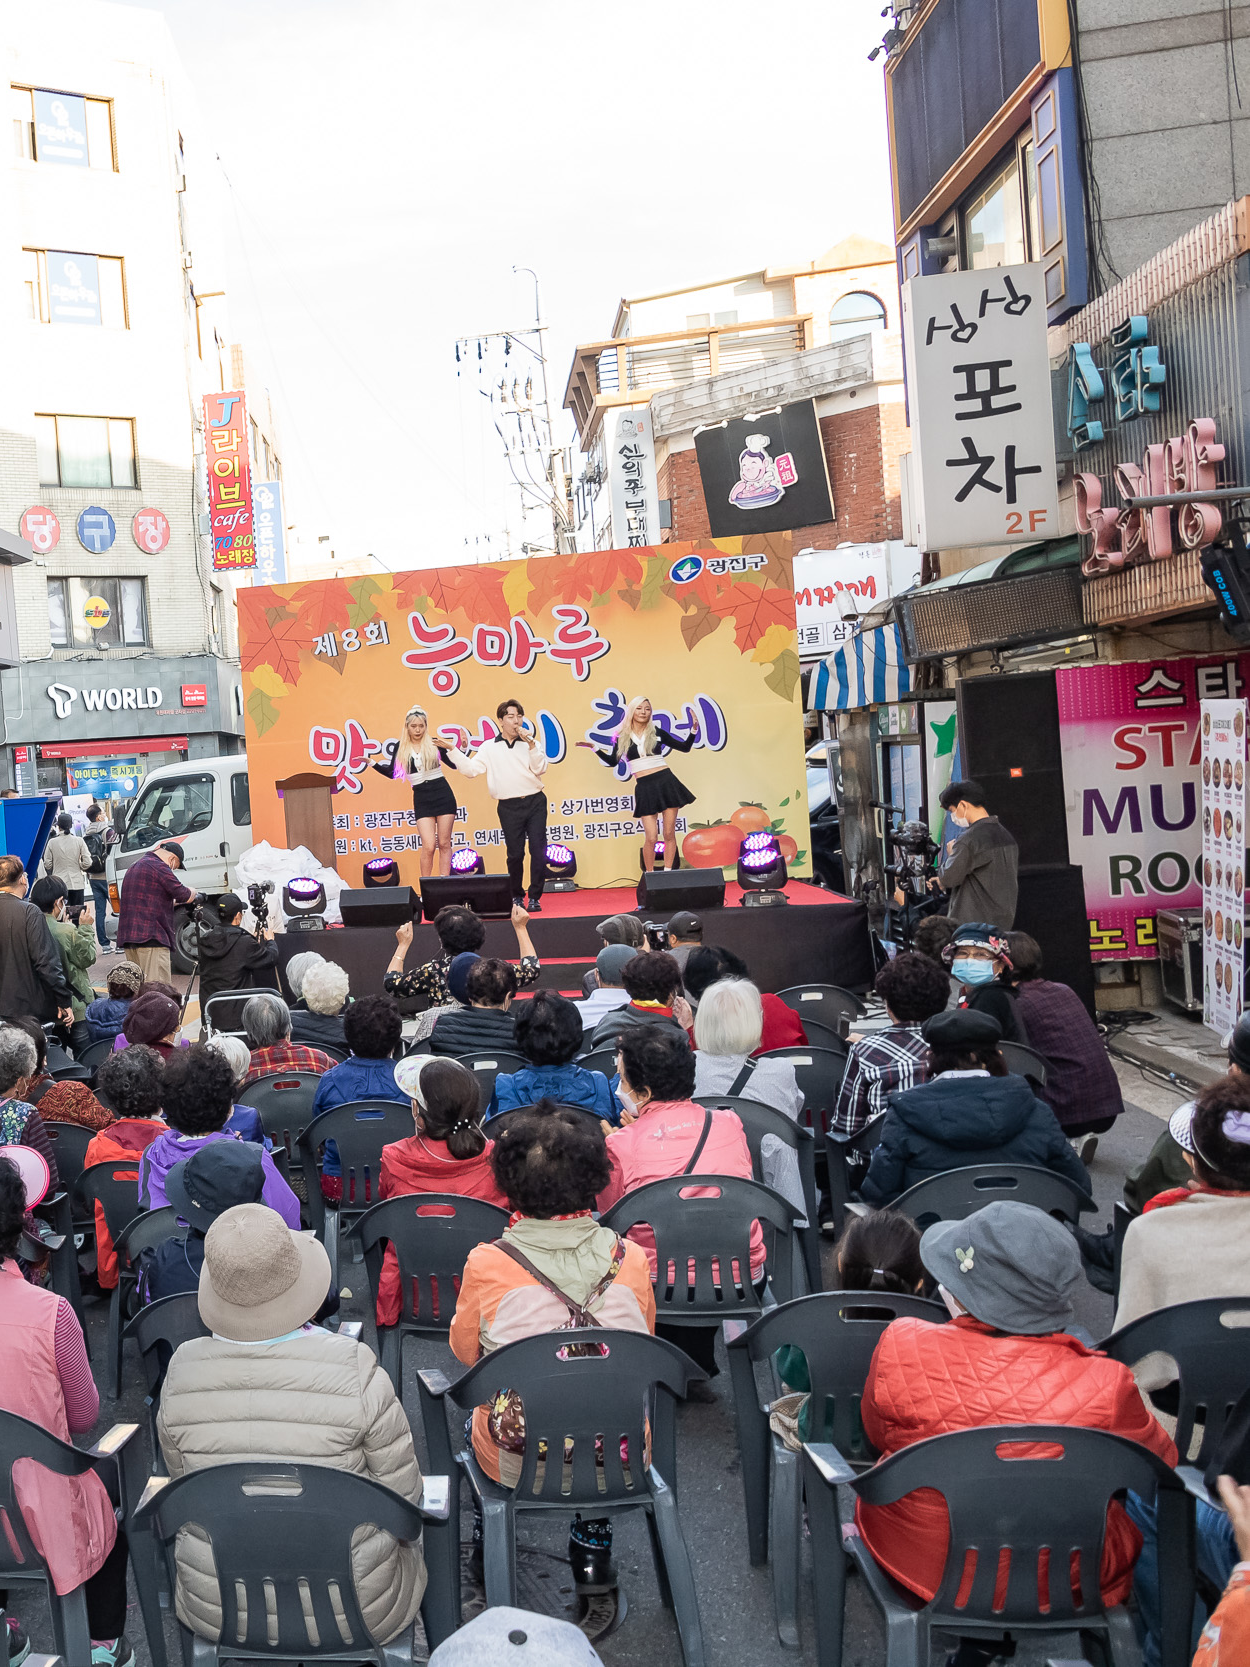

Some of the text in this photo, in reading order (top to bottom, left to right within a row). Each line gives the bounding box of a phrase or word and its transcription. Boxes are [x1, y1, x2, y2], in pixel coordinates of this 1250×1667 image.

[618, 443, 646, 496] 신의주
[213, 507, 250, 533] cafe
[1004, 509, 1049, 535] 2F
[215, 548, 255, 565] 노래장
[707, 554, 768, 574] 광진구
[311, 619, 391, 658] 제8회
[402, 604, 611, 697] 능마루
[81, 686, 163, 711] WORLD
[561, 796, 635, 815] 상가번영회
[1108, 851, 1204, 898] RO
